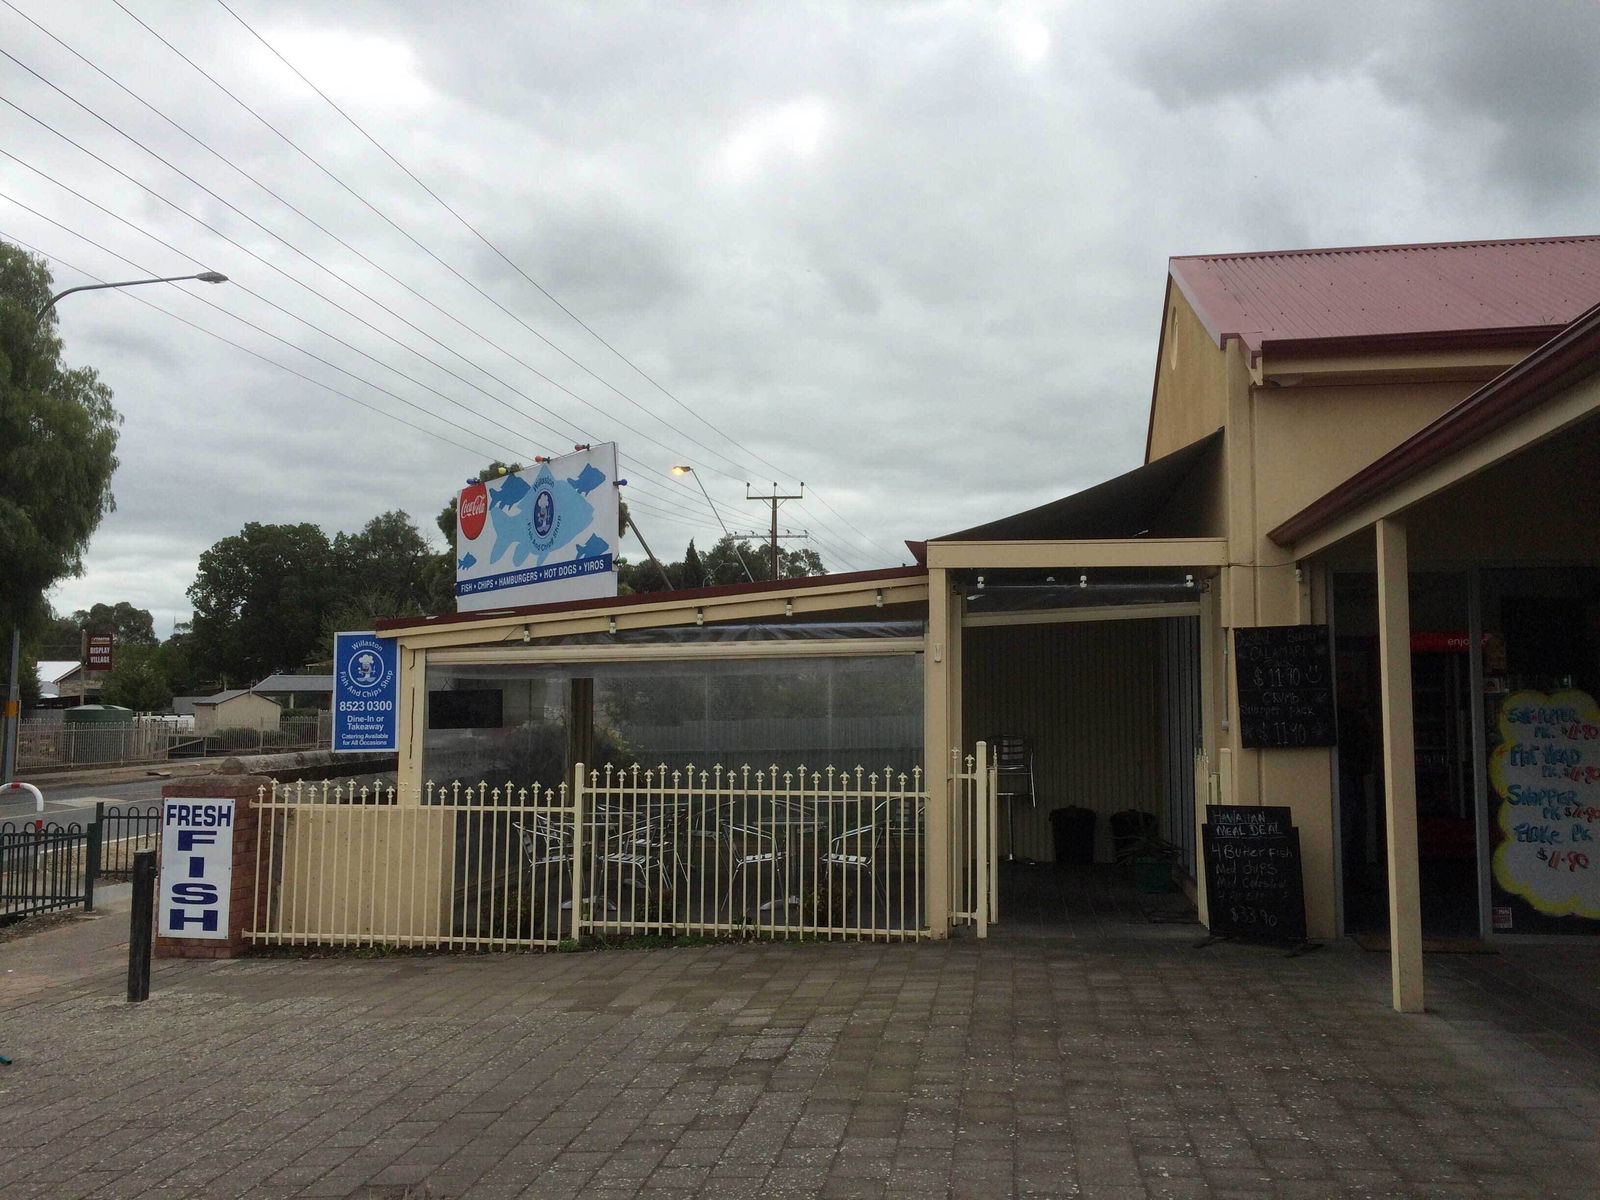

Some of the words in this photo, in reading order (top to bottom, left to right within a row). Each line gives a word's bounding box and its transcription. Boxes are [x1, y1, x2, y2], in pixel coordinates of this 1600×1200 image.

[461, 583, 472, 593] FISH
[477, 579, 494, 590] CHIPS
[498, 572, 538, 586] HAMBURGERS
[544, 569, 558, 579] HOT
[558, 564, 577, 576] DOGS
[584, 559, 604, 572] YIROS
[351, 640, 384, 653] Willaston
[1447, 636, 1470, 649] enjo
[90, 656, 110, 664] VILLAGE
[339, 671, 349, 687] Fish
[346, 685, 361, 697] And
[362, 688, 382, 698] Chips
[380, 670, 394, 689] Shop
[339, 701, 365, 712] 8523
[366, 700, 393, 711] 0300
[347, 715, 375, 723] Dine-In
[347, 723, 384, 732] Takeaway
[166, 804, 232, 827] FRESH
[169, 829, 219, 932] FISH
